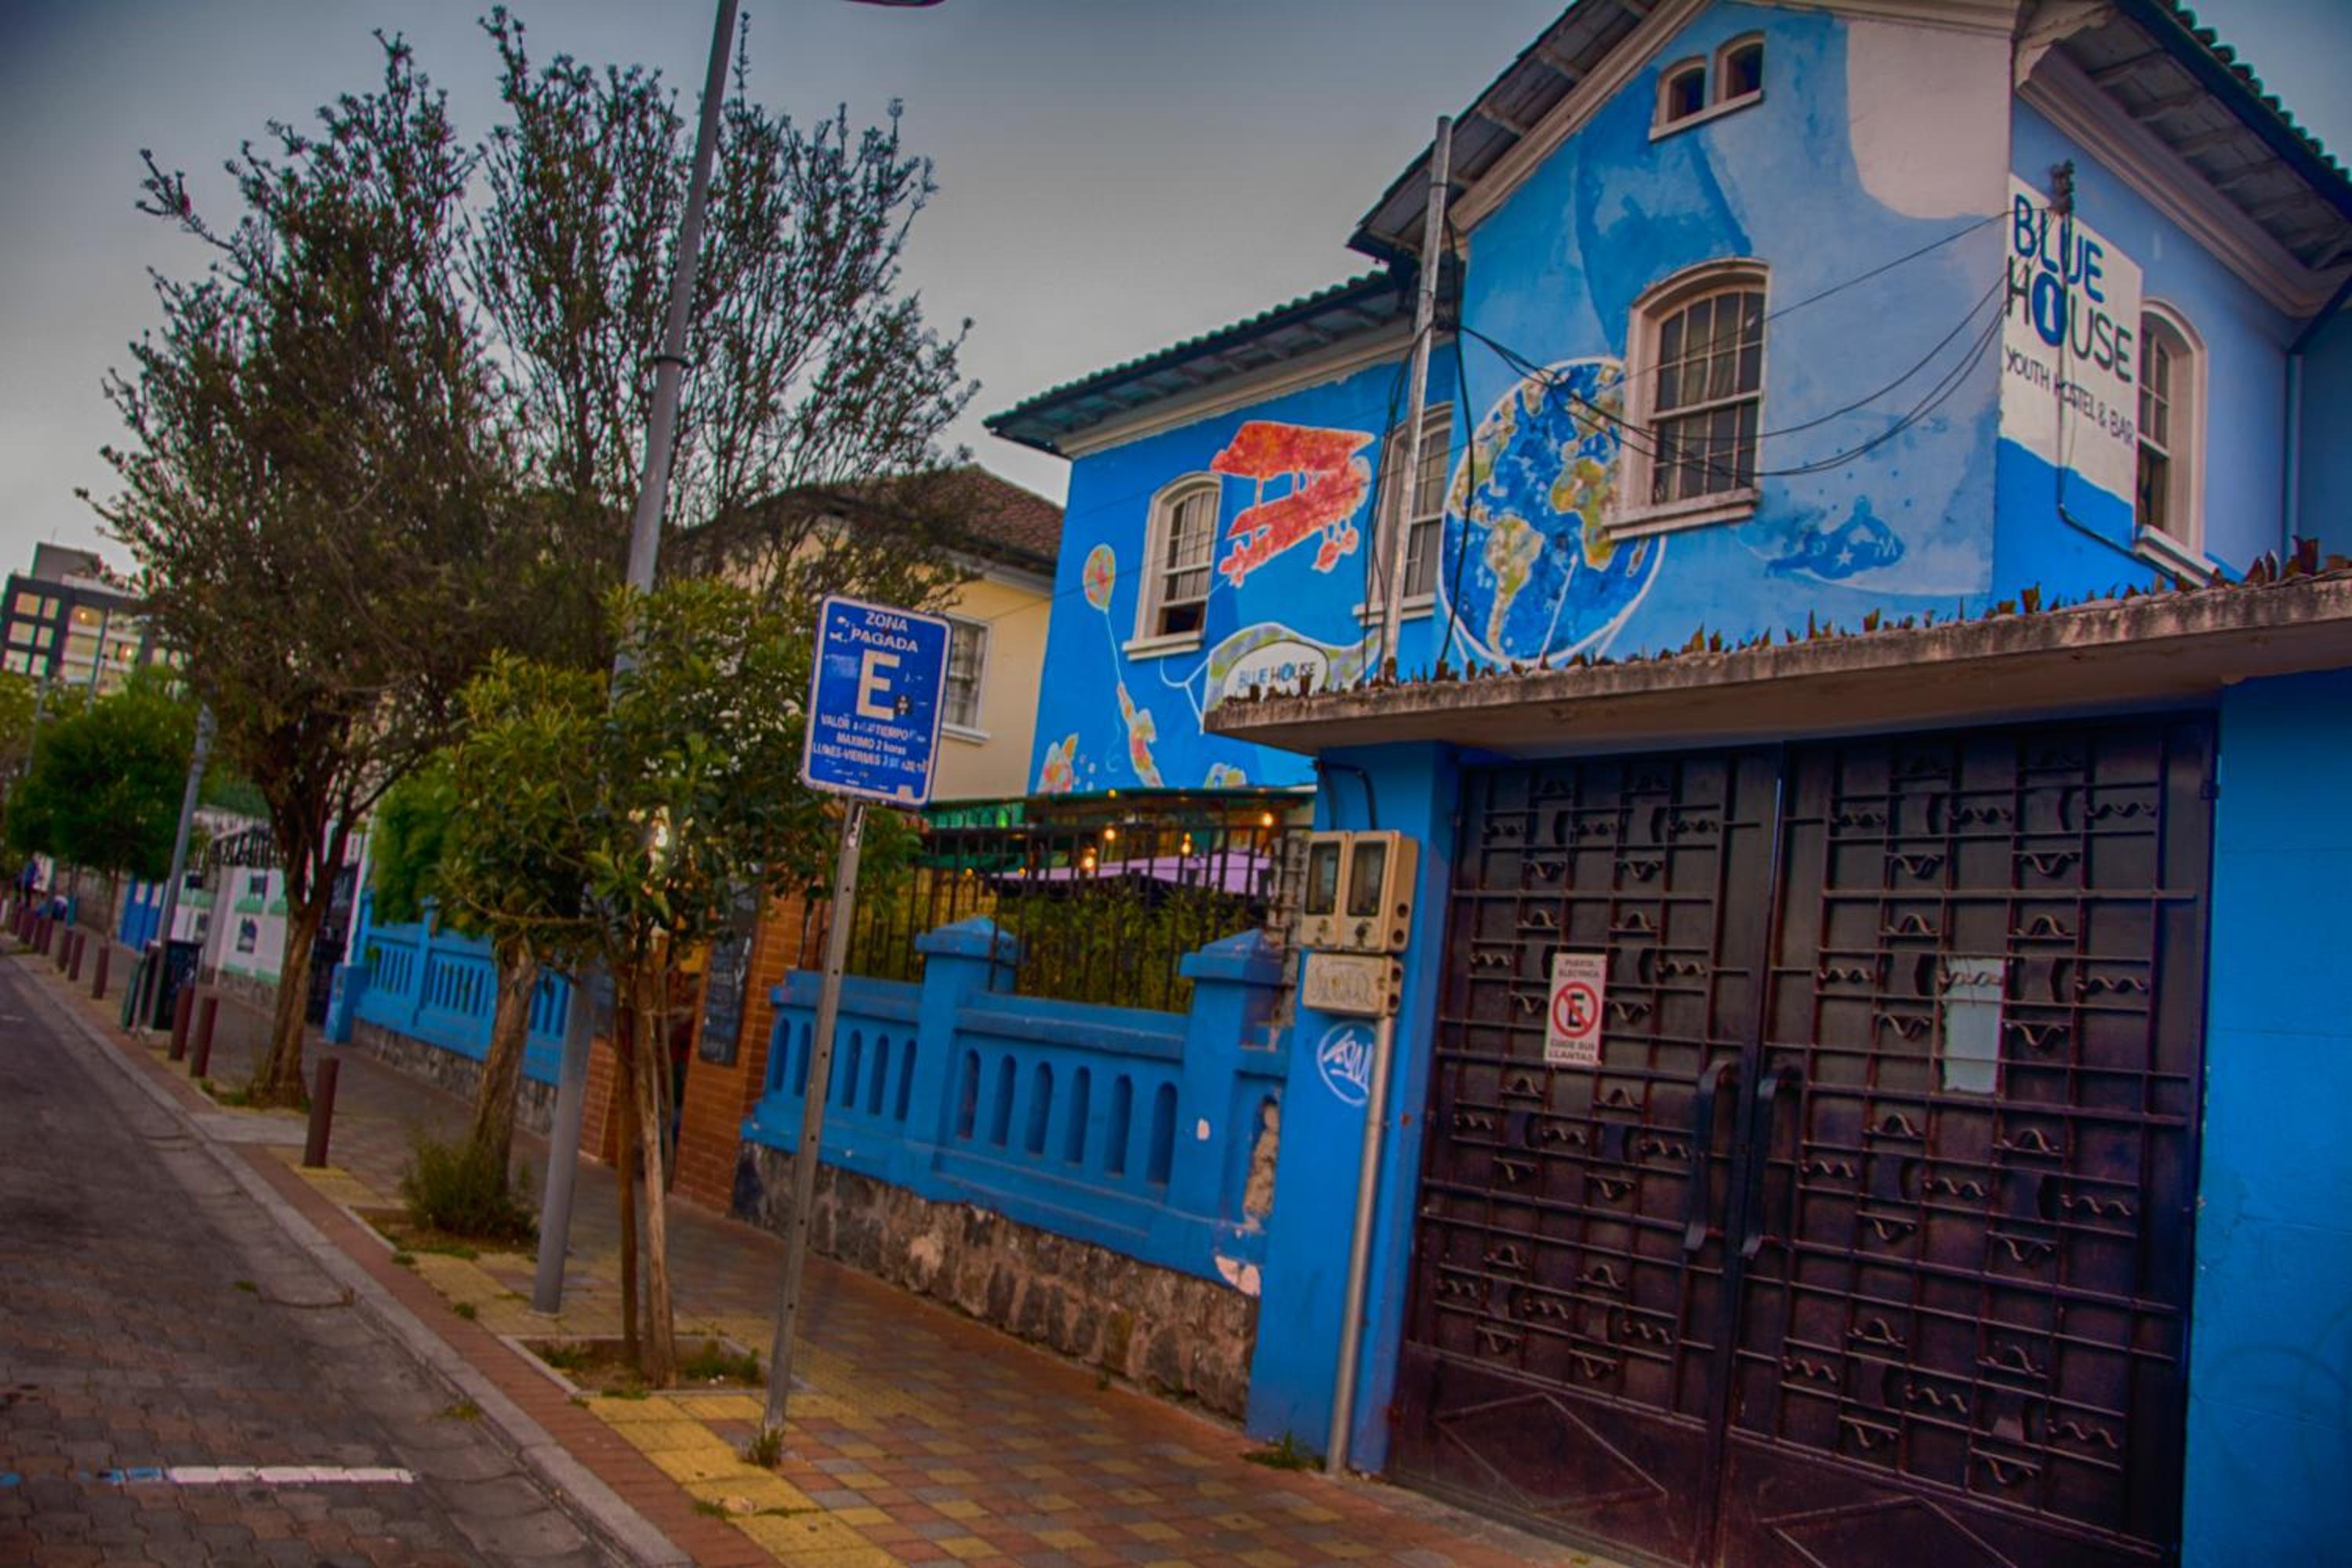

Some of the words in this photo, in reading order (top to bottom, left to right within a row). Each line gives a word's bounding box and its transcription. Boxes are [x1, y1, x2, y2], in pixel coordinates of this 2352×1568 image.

[2013, 194, 2104, 303] BLUE
[2007, 255, 2134, 383] HOUSE
[2005, 343, 2050, 391] YOUTH
[2053, 372, 2096, 421] HOSTEL
[2097, 401, 2107, 427] &
[851, 626, 919, 653] PAGADA
[865, 610, 909, 633] ZONA
[857, 649, 900, 720] E
